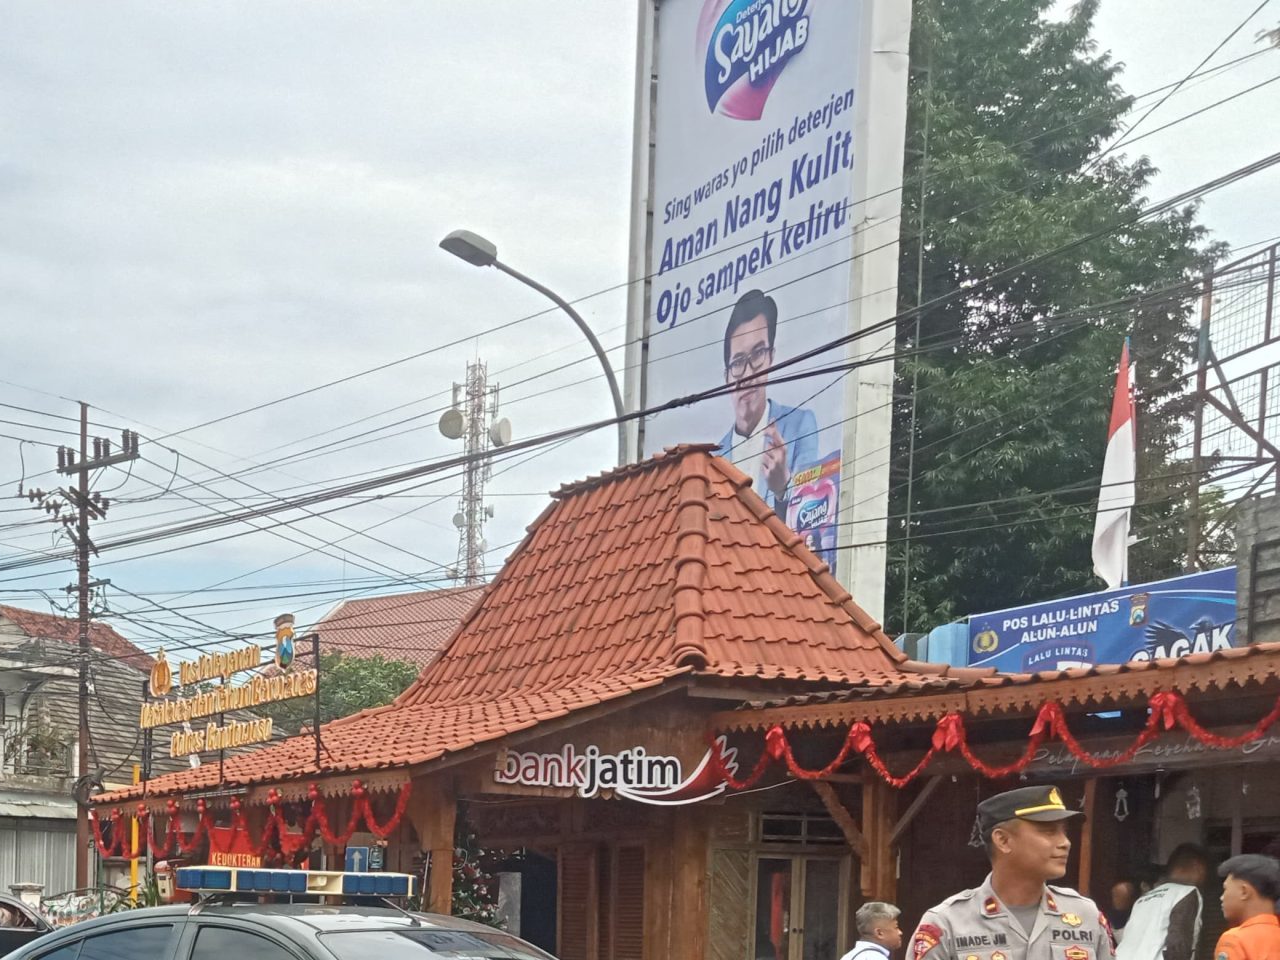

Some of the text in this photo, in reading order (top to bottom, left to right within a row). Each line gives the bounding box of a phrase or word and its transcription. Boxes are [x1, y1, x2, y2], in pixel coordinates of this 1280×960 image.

[736, 0, 766, 23] Deterj
[749, 17, 808, 82] HIJAB
[664, 88, 854, 225] Sing waras yo pilih deterjen
[658, 130, 854, 276] Aman Nang Kulit,
[656, 281, 691, 328] Ojo
[696, 230, 775, 305] sampek
[1002, 600, 1120, 632] POS LALU-LINTAS
[1021, 619, 1098, 644] ALUN-ALUN
[1028, 646, 1089, 666] LALU LINTAS
[496, 744, 681, 798] bankjatim
[1052, 930, 1093, 942] POLRI
